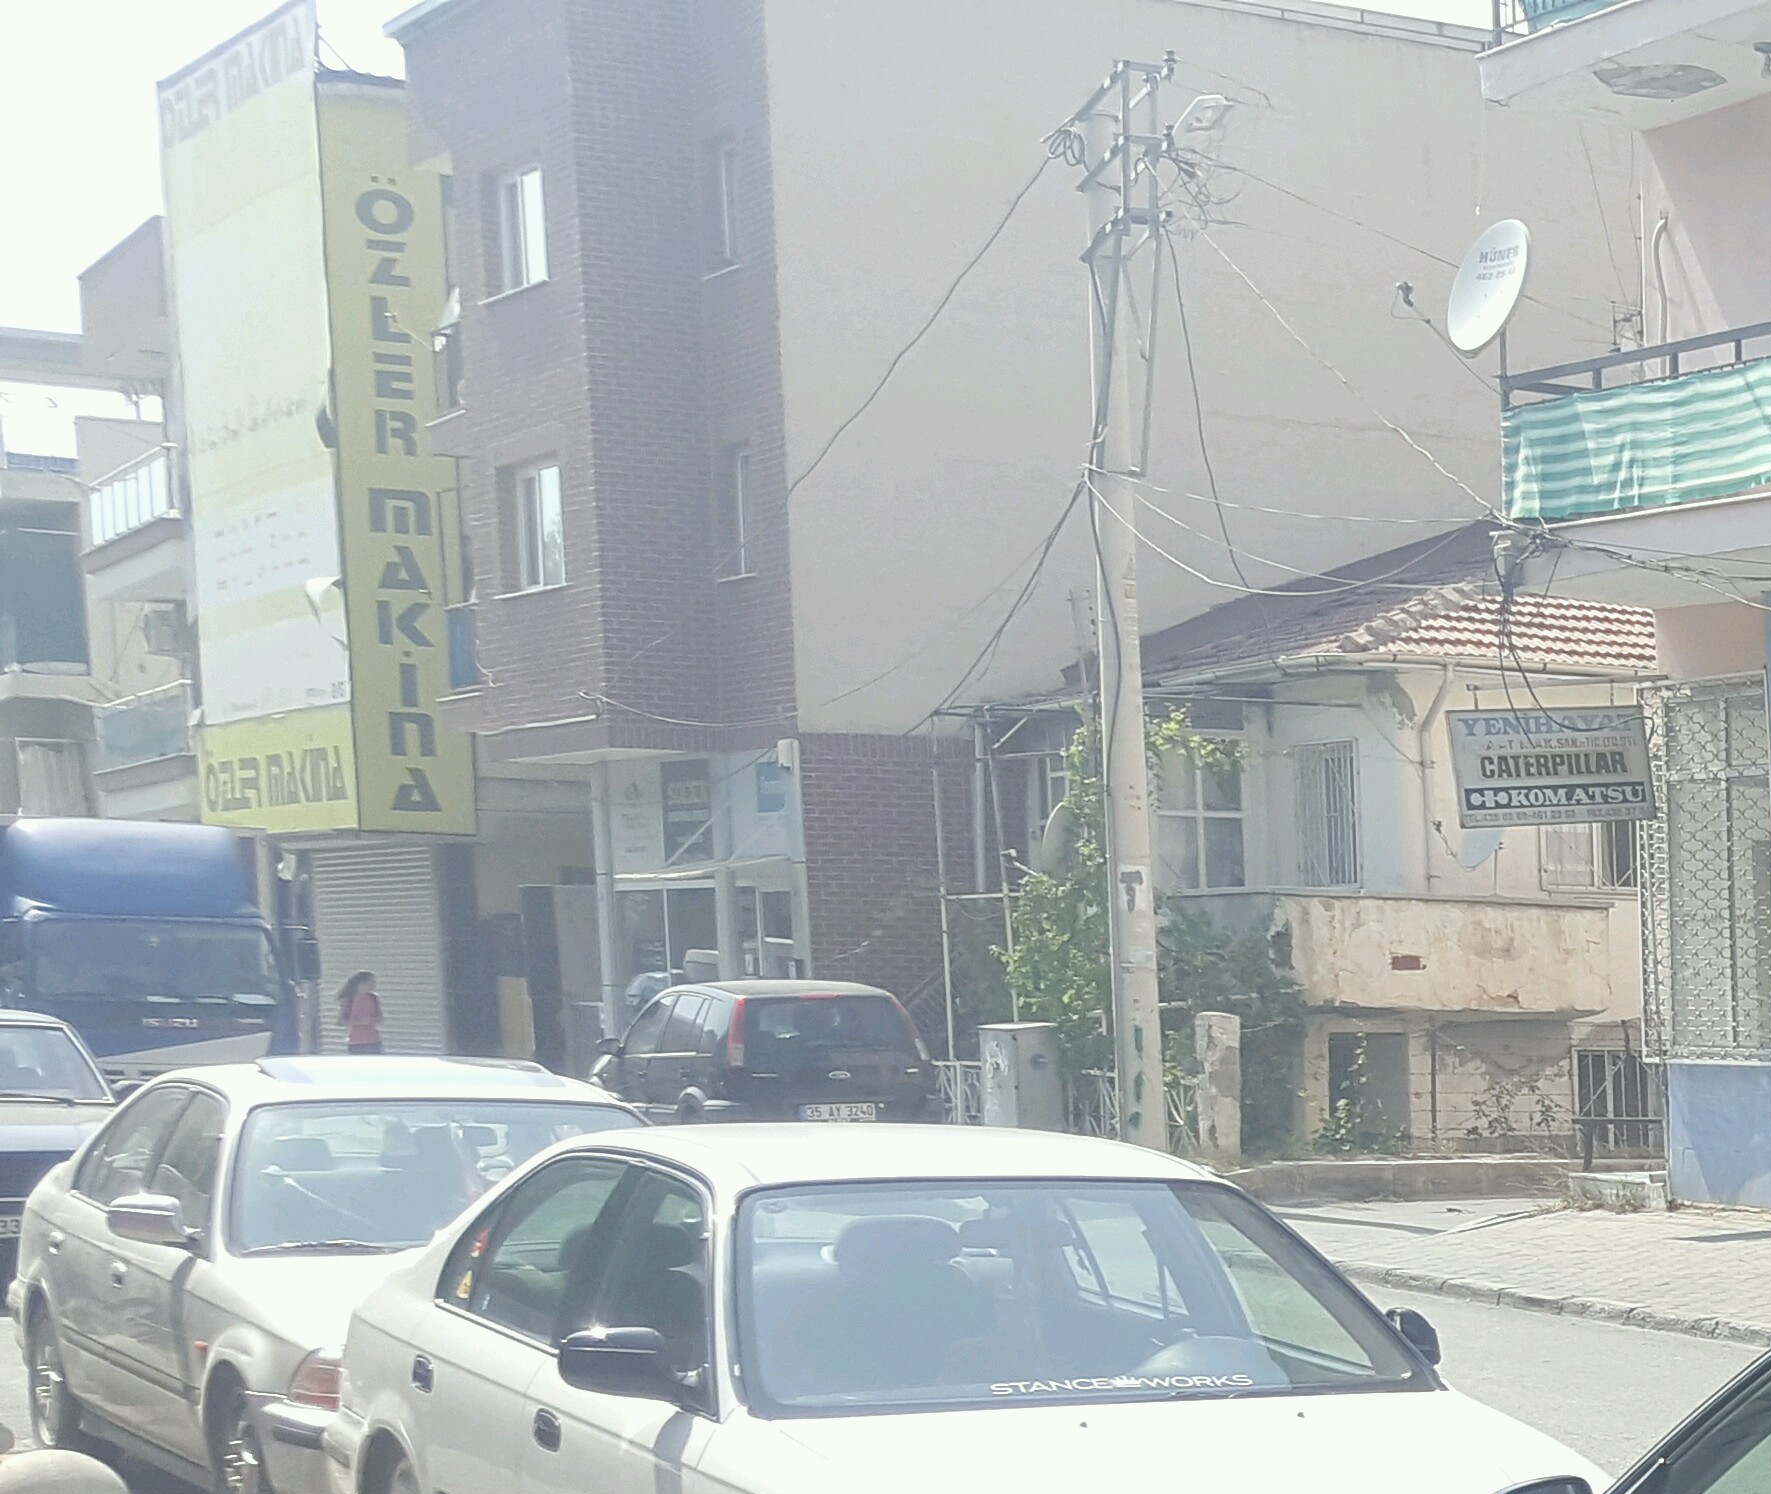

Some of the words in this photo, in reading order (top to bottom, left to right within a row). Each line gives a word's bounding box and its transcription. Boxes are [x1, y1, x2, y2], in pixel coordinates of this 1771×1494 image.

[355, 175, 418, 457] ÖZLER
[1479, 751, 1629, 779] CATERPILLAR
[1508, 785, 1645, 807] KOMATSU
[989, 1377, 1114, 1395] STANCE
[1140, 1374, 1255, 1388] WORKS
